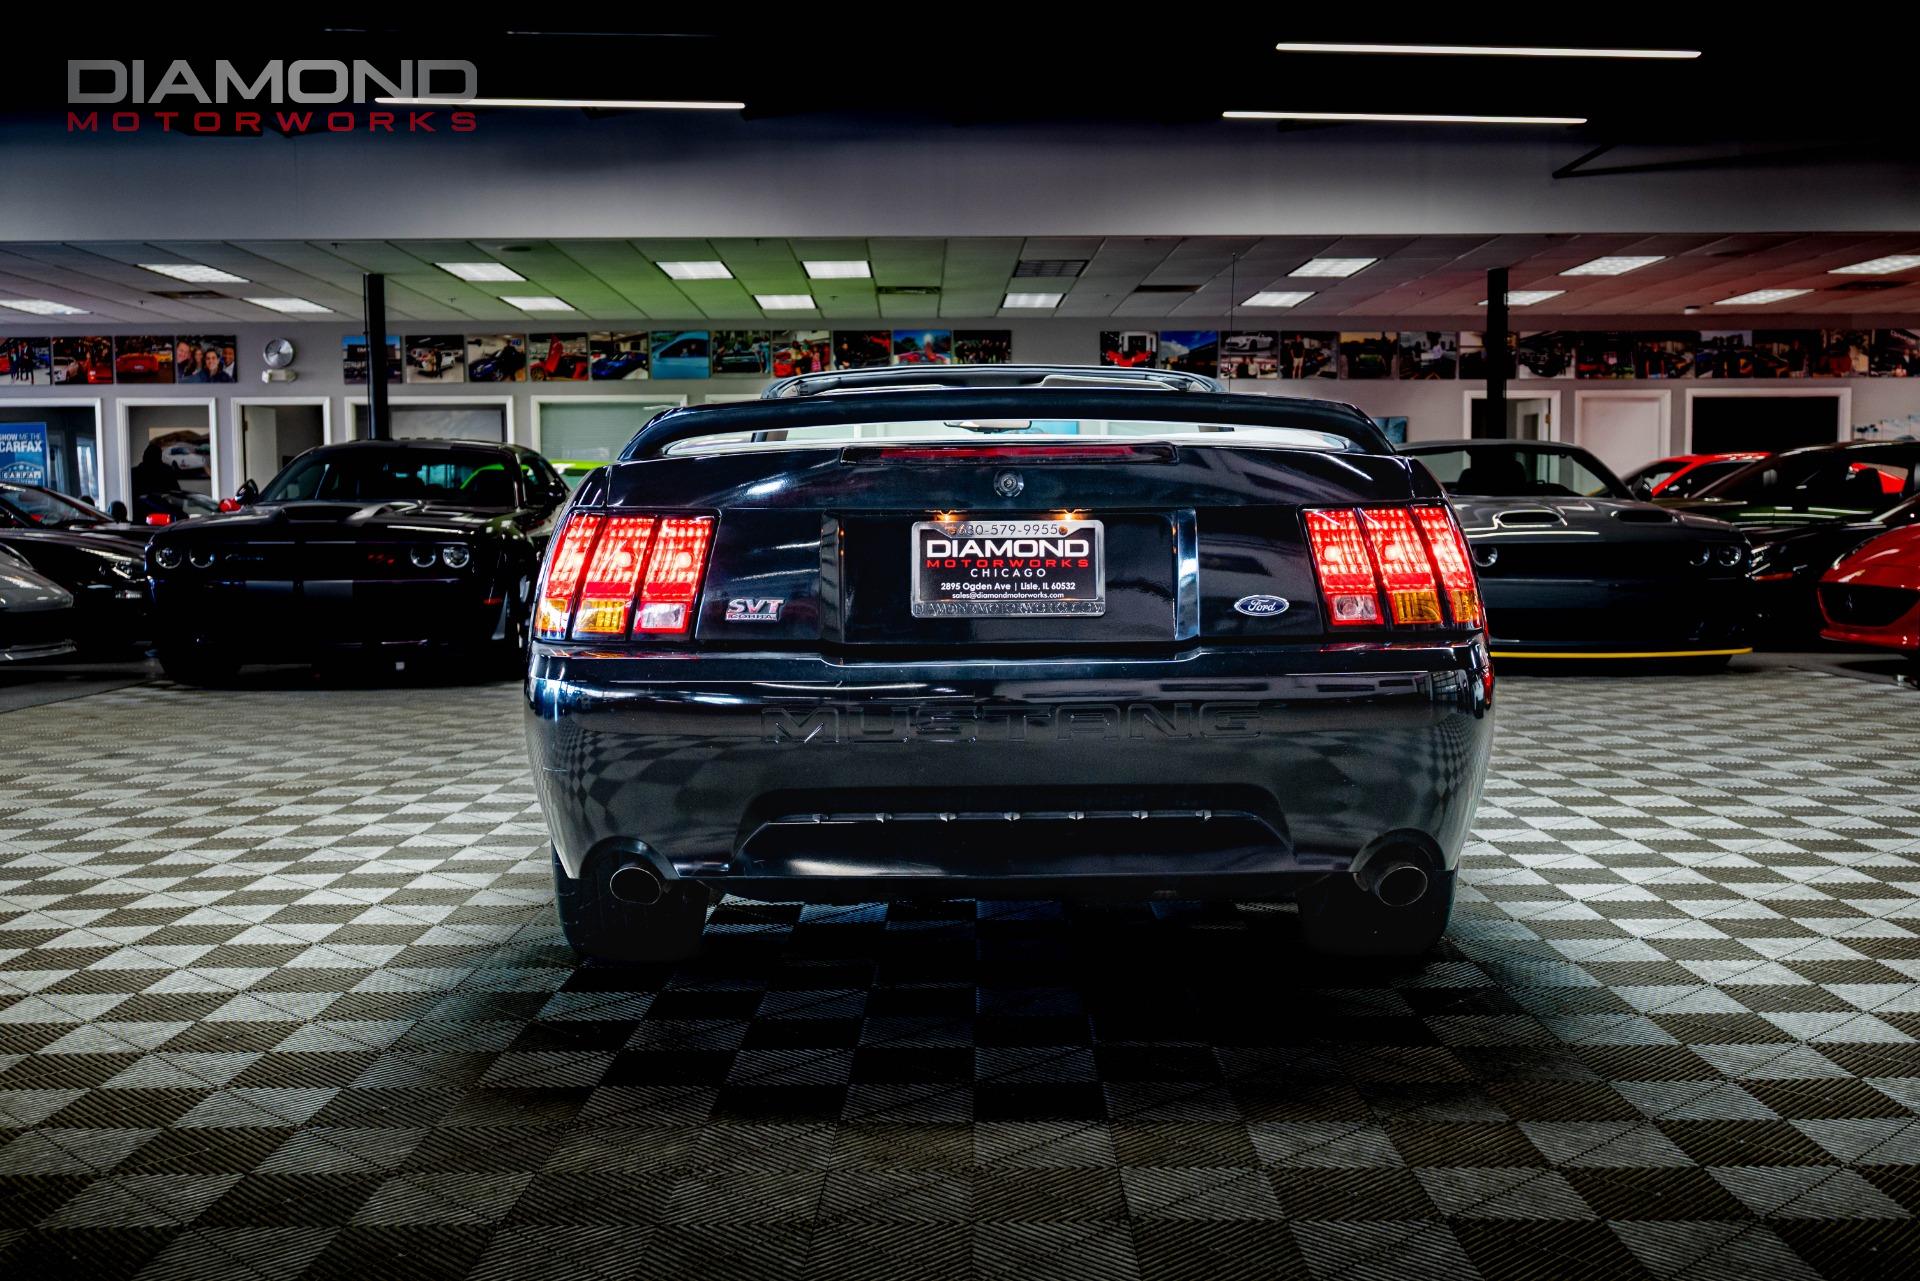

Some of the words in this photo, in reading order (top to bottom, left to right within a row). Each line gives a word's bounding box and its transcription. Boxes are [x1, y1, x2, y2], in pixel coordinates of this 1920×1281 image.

[0, 441, 42, 453] CARFAX
[926, 539, 1090, 558] DIAMOND
[926, 559, 1089, 568] MOTORWORKS
[970, 568, 1046, 578] CHICAGO
[940, 582, 961, 590] 2895
[962, 582, 992, 591] Ogden
[994, 582, 1011, 590] Ave
[1020, 582, 1041, 590] Lisle,
[1042, 582, 1050, 590] IL
[1051, 582, 1076, 590] 60532
[952, 592, 1065, 600] sales@diamondmotorworks.com
[728, 598, 785, 613] SVT
[1247, 599, 1276, 612] Ford
[761, 703, 1262, 744] MUSTANG
